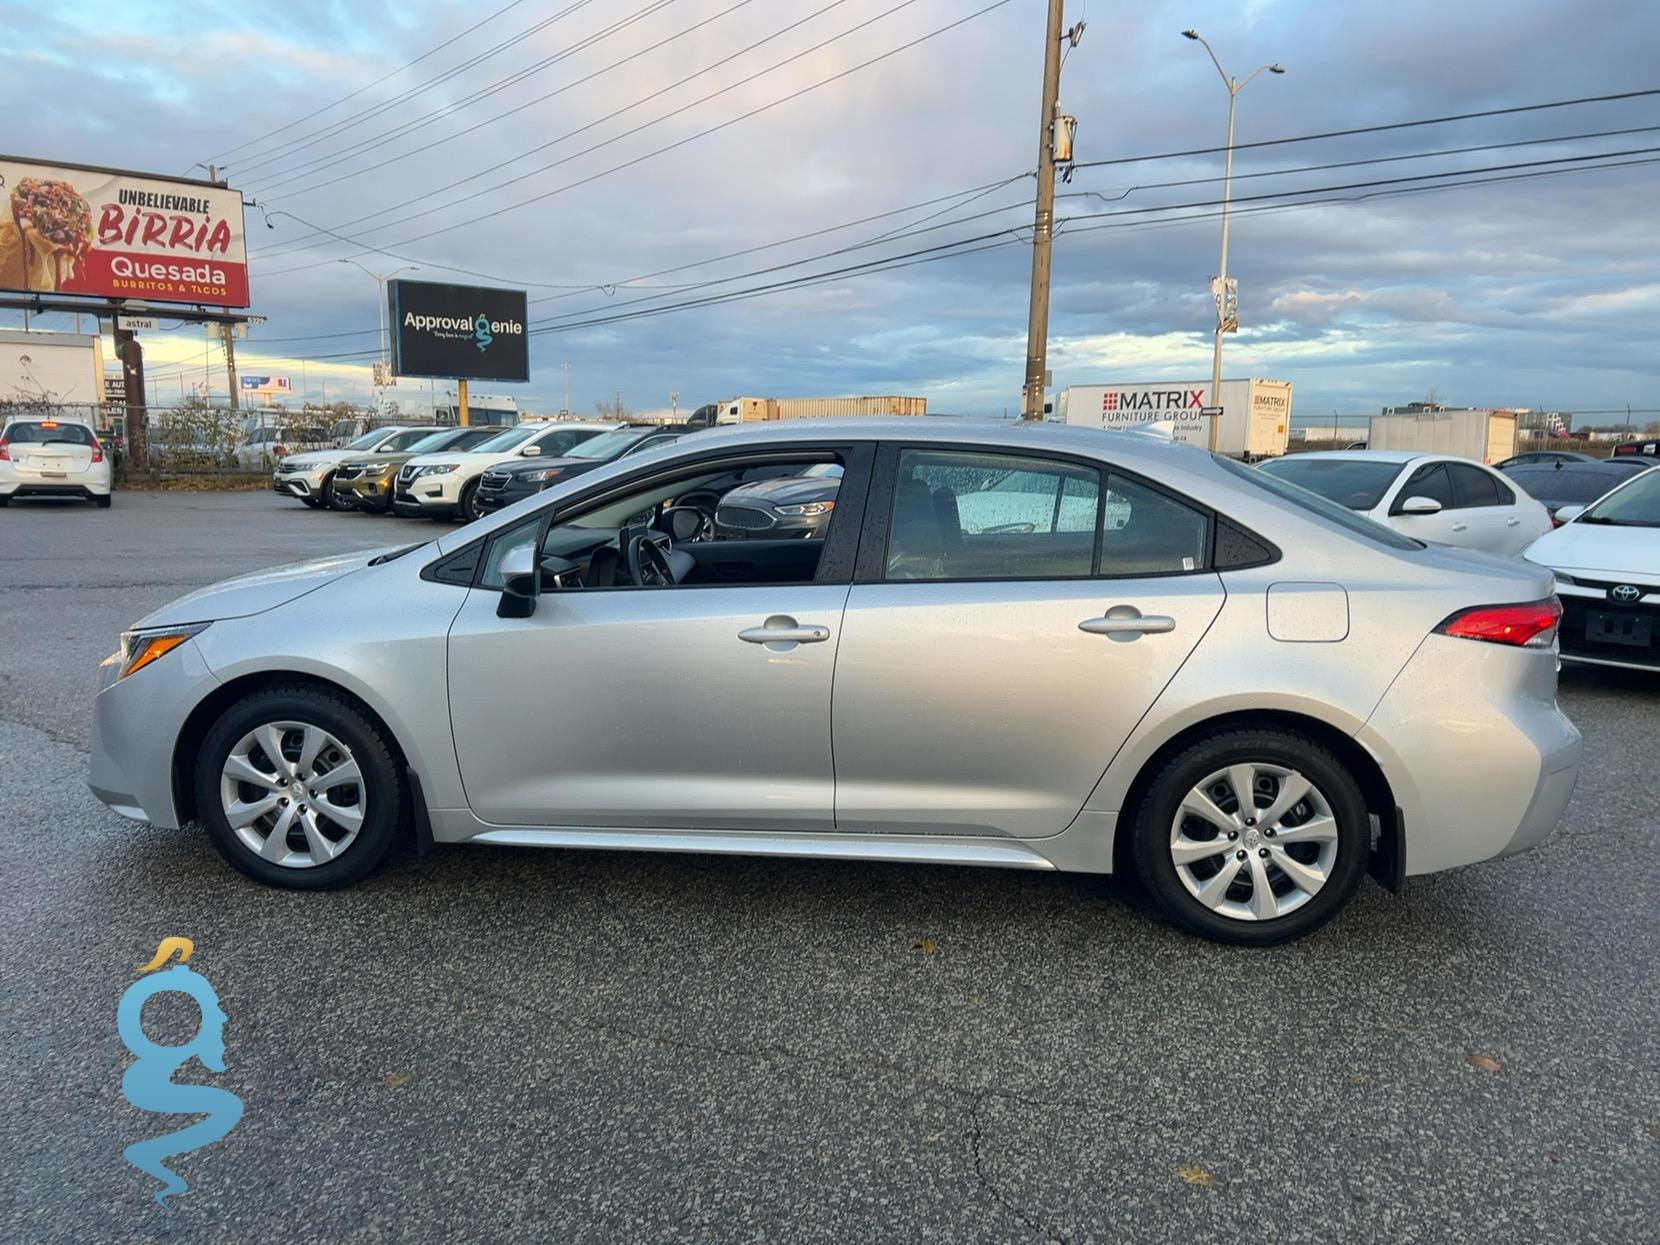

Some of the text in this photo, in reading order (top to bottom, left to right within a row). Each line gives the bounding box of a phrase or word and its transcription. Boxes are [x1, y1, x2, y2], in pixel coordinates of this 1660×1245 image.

[118, 189, 210, 214] UNBELIEVABLE
[111, 256, 226, 285] Quesada
[113, 279, 173, 291] BURRITOS
[179, 284, 186, 292] &
[126, 320, 152, 328] astral
[1120, 390, 1205, 410] MATRIX
[1260, 396, 1286, 406] MATRIX
[1102, 411, 1160, 422] FURNITURE
